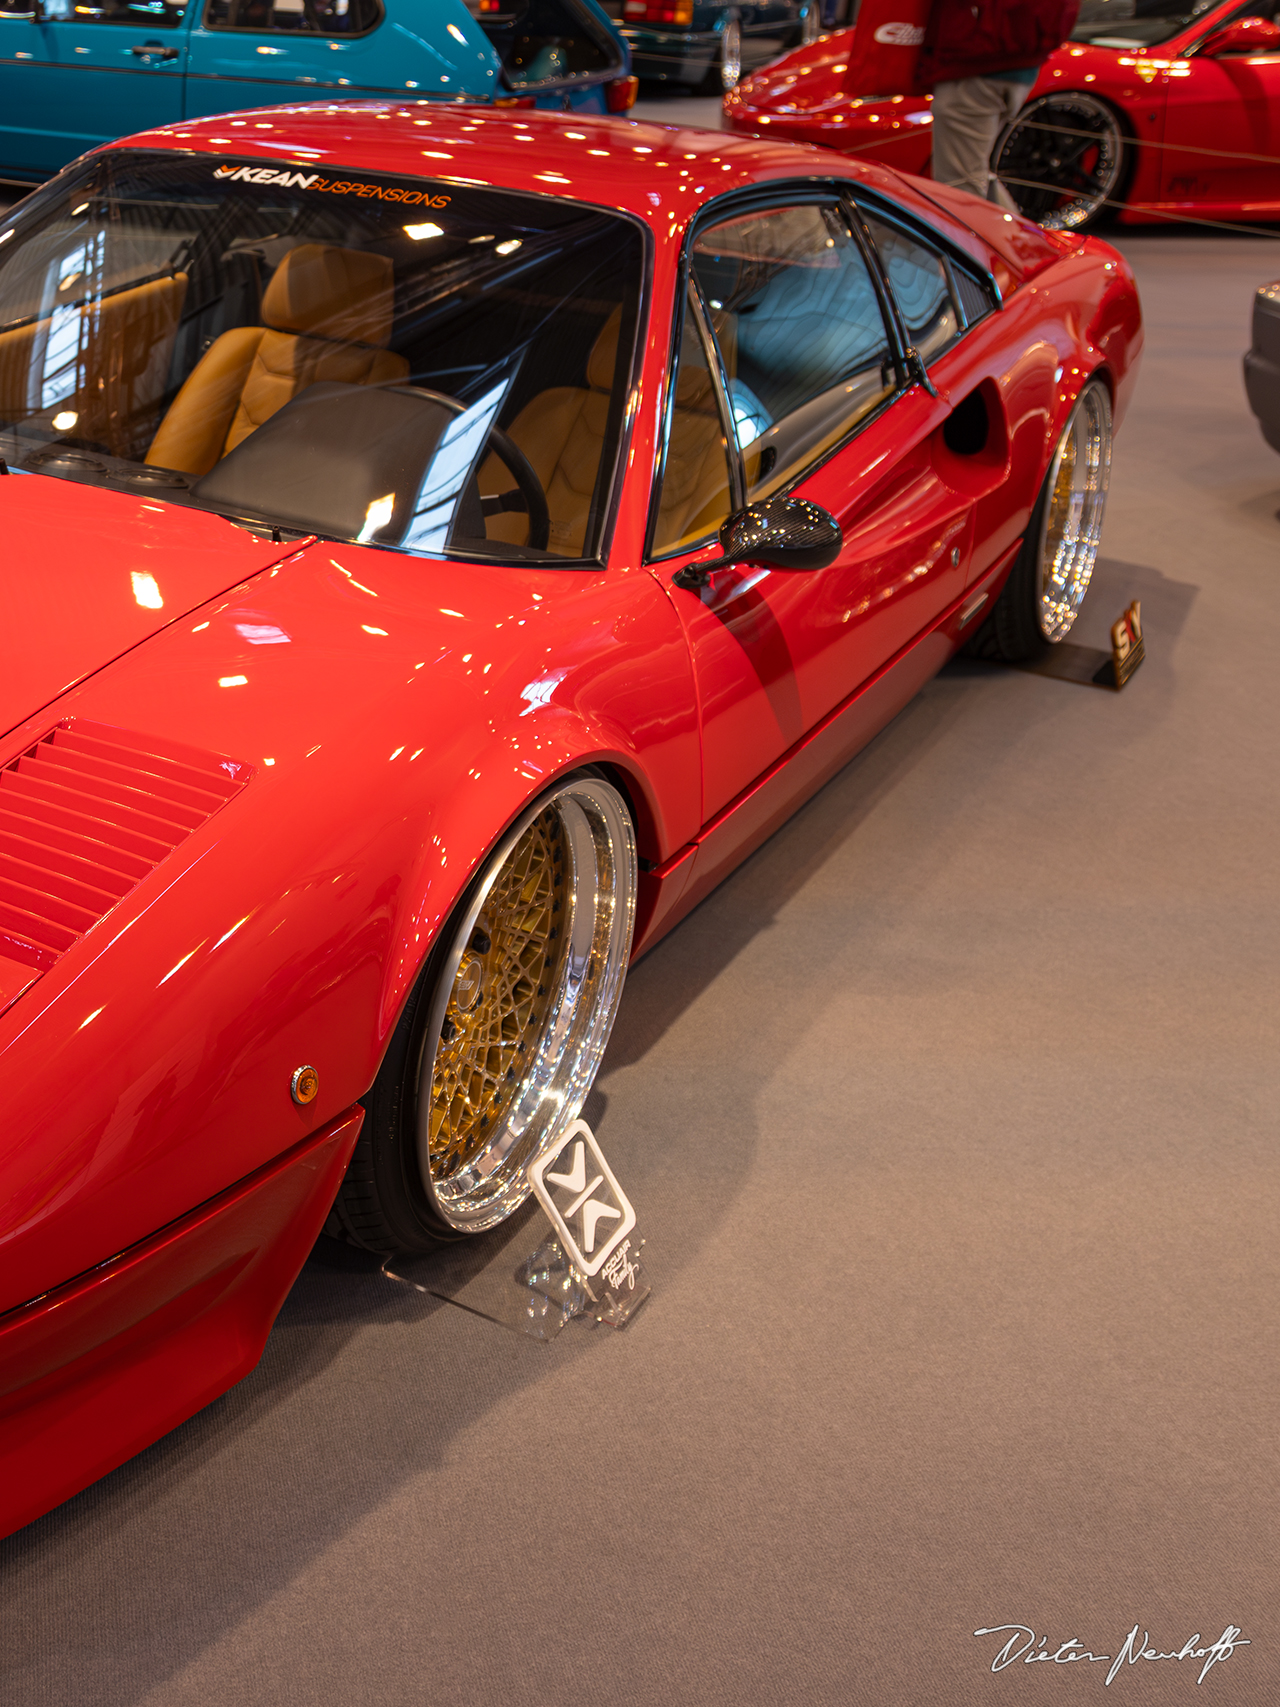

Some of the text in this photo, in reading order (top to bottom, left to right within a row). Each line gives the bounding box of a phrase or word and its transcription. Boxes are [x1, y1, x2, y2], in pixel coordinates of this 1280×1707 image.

[230, 166, 452, 209] KEAN SUSPENSIONS
[601, 1239, 632, 1280] ACCUAIR
[608, 1253, 639, 1290] Family
